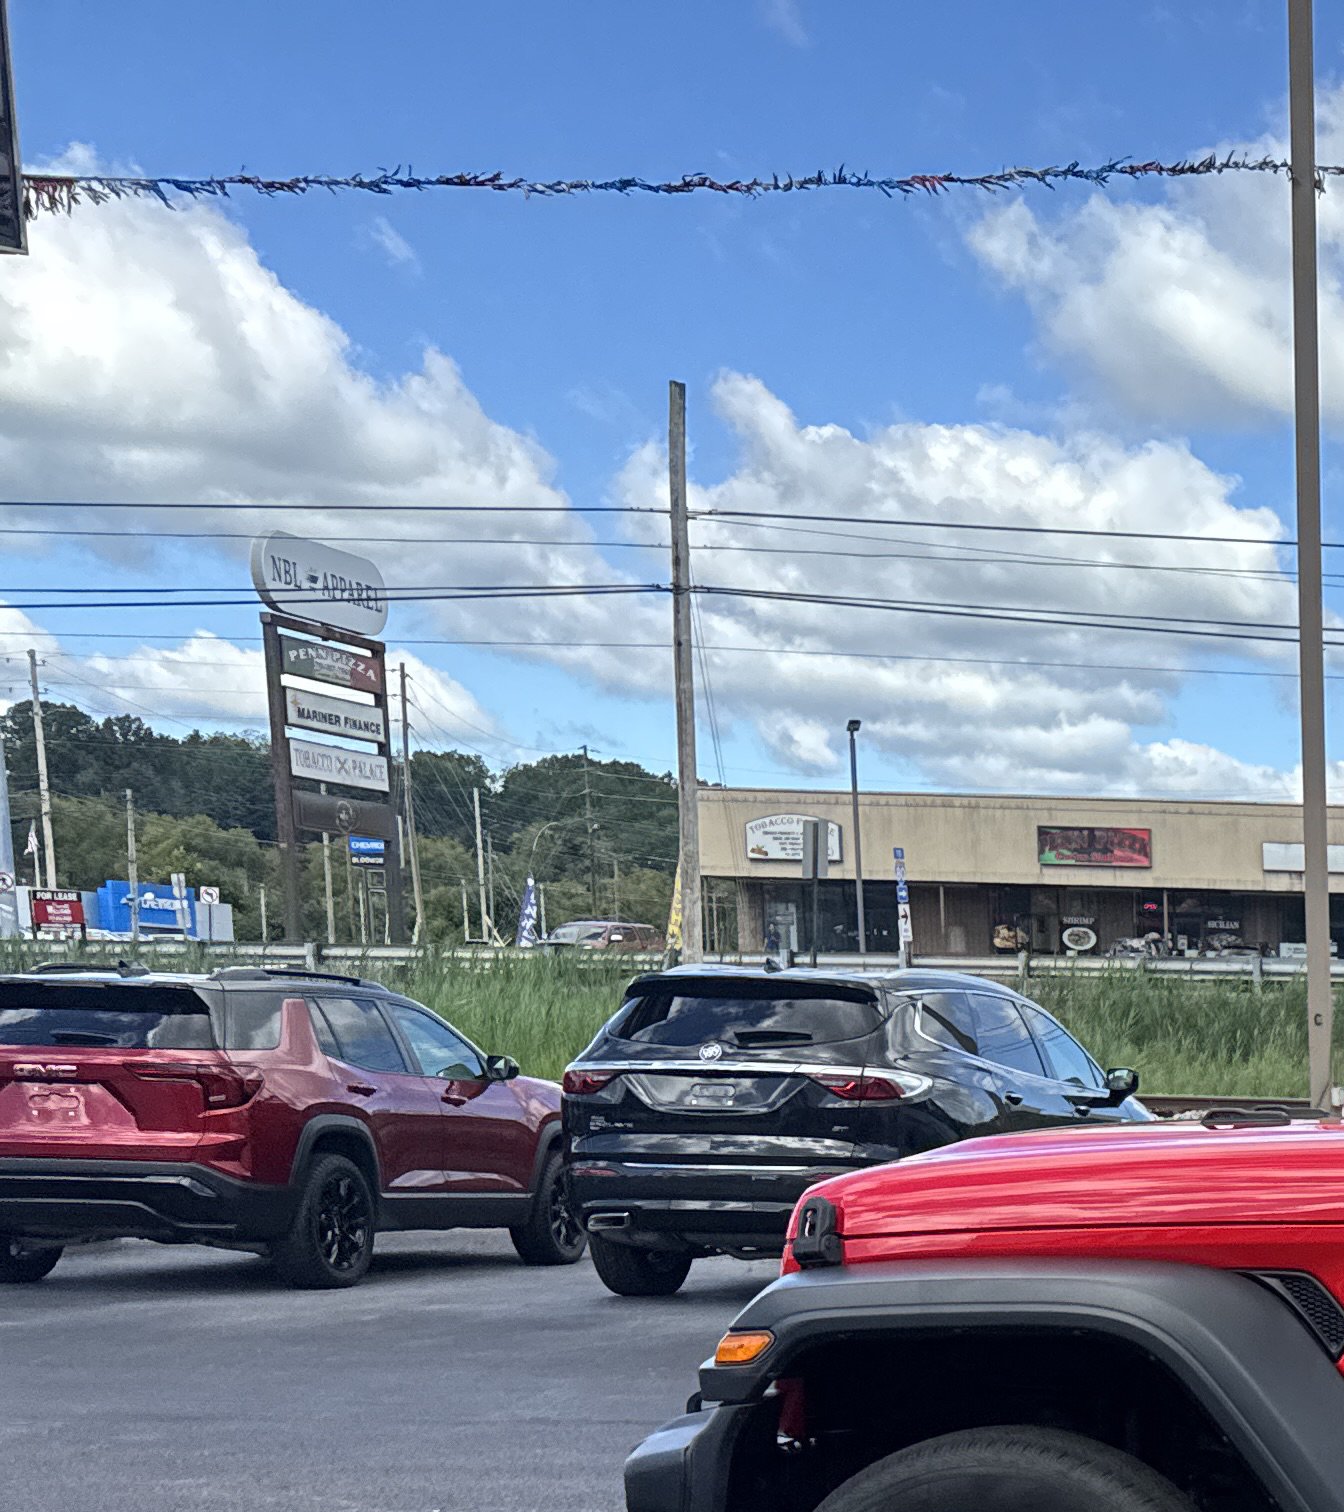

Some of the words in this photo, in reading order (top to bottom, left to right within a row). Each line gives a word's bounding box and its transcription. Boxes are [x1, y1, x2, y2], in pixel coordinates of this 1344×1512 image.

[270, 554, 302, 590] NBL
[321, 571, 383, 613] APPAREL
[288, 646, 328, 662] PENN
[333, 651, 377, 682] PIZZA
[296, 706, 341, 728] MARINER
[344, 716, 382, 736] FINANCE
[293, 747, 333, 773] TOBACCO
[748, 816, 794, 835] TOBACCO
[36, 891, 53, 900] FOR
[54, 892, 78, 900] LEASE
